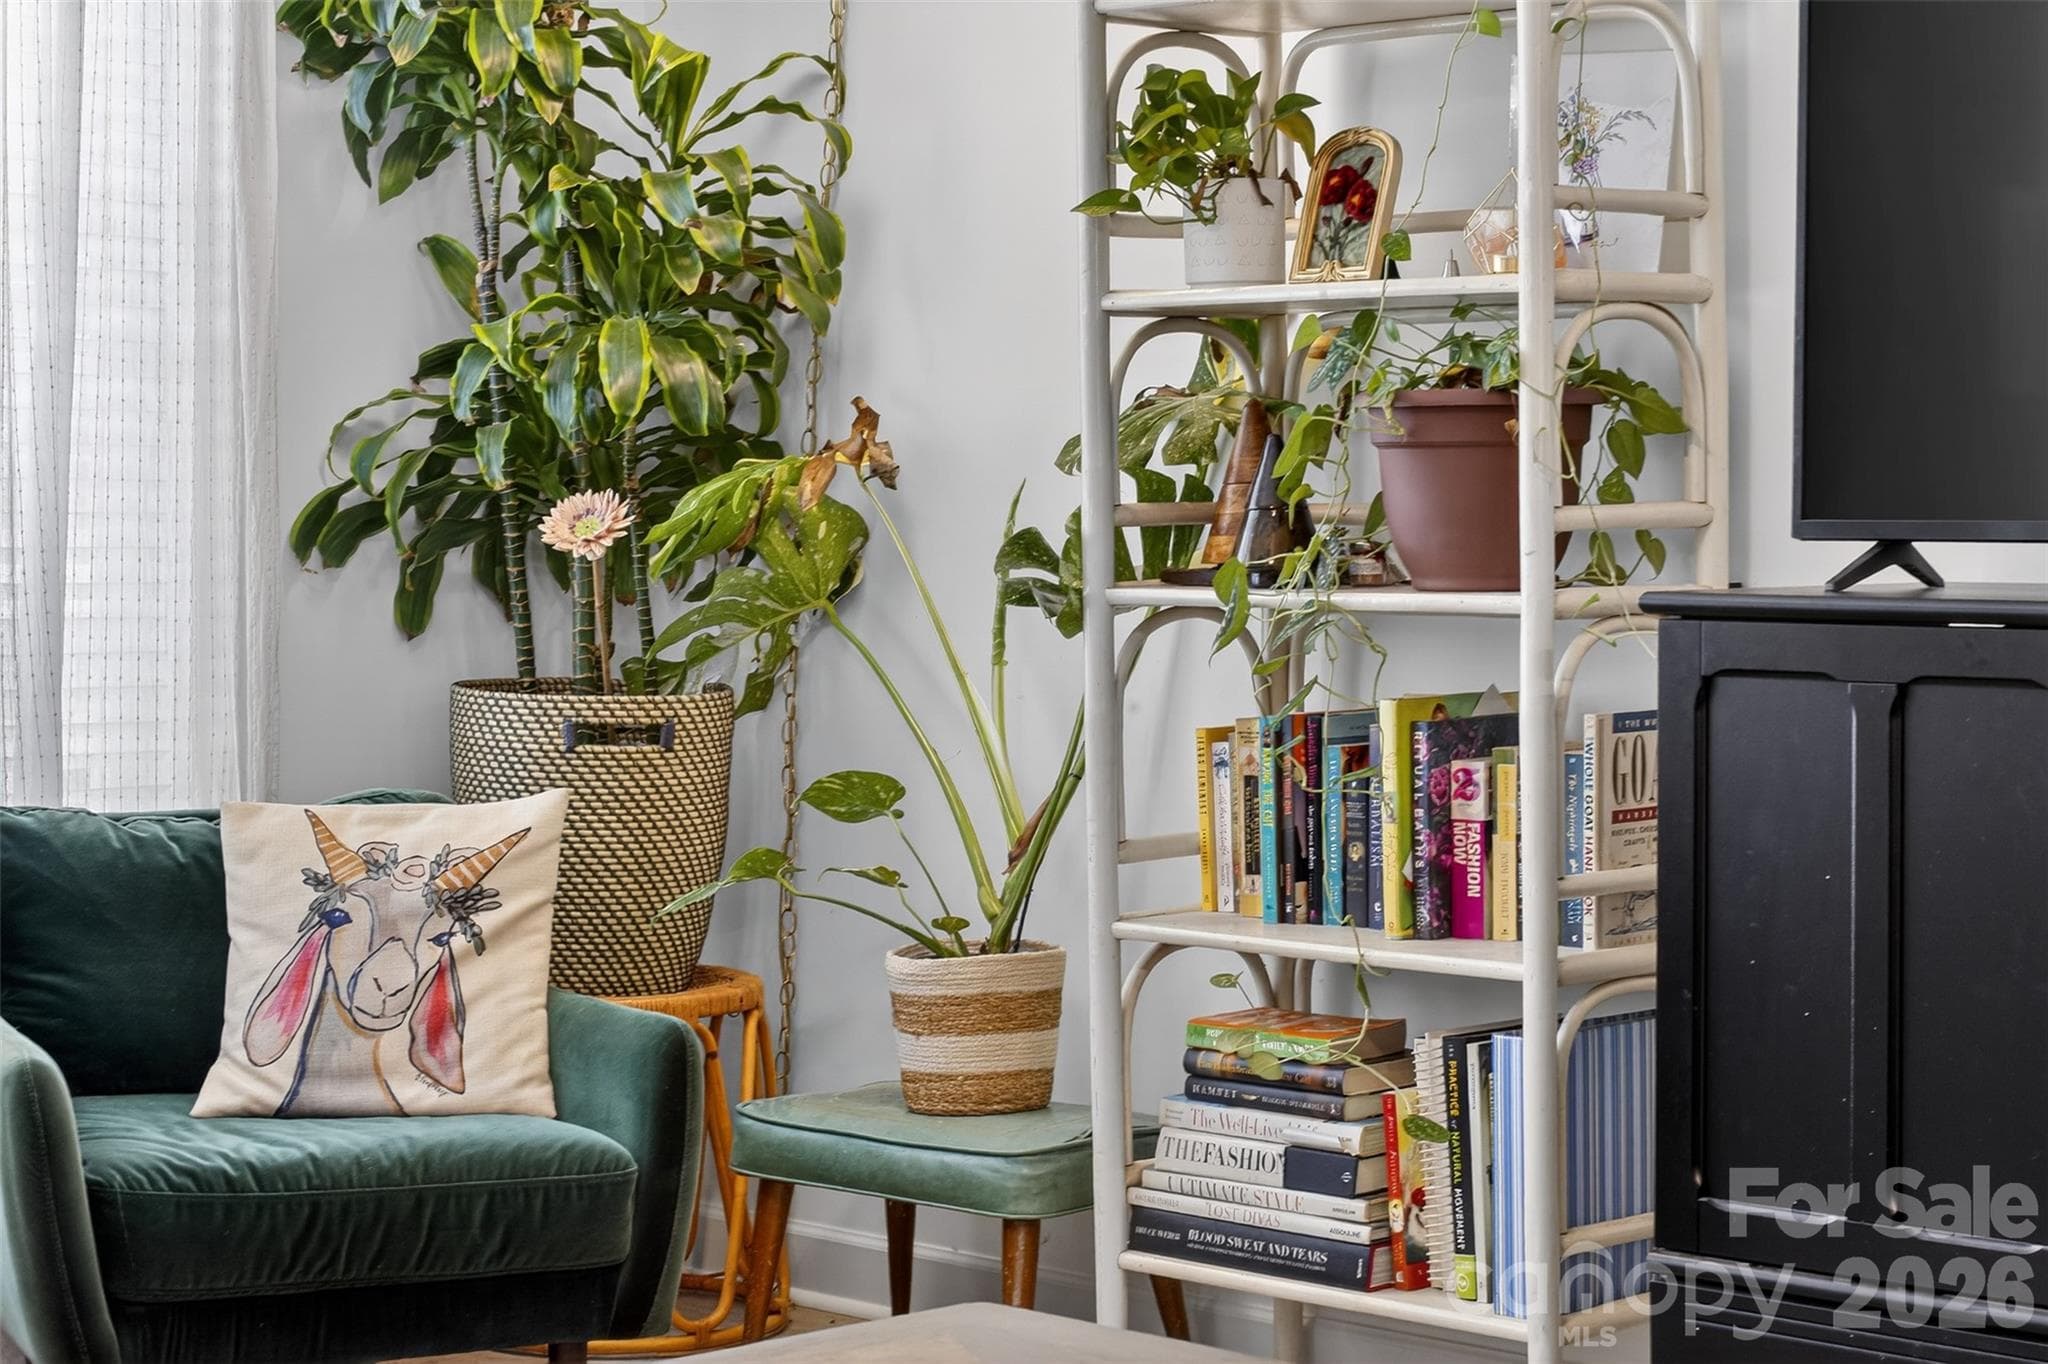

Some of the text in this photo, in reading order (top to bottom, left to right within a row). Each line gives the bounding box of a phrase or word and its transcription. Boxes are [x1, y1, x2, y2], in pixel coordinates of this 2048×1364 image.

[1413, 731, 1424, 800] RITUAL
[1566, 795, 1578, 852] Nightingale
[1585, 794, 1595, 832] GOAT
[1453, 822, 1468, 865] NOW
[1467, 822, 1481, 898] FASHION
[1191, 1083, 1238, 1099] HAMNET
[1448, 1060, 1460, 1117] PRACTICE
[1190, 1108, 1216, 1129] The
[1163, 1135, 1200, 1162] THE
[1450, 1131, 1463, 1186] NATURAL
[1167, 1175, 1249, 1205] ULTIMATE
[1253, 1189, 1305, 1213] STYLE
[1205, 1202, 1281, 1228] LOST DIVAS
[1454, 1187, 1466, 1251] MOVEMENT
[1187, 1228, 1226, 1246] BLOOD
[1226, 1235, 1266, 1253] SWEAT
[1268, 1242, 1291, 1258] AND
[1290, 1245, 1329, 1264] TEARS
